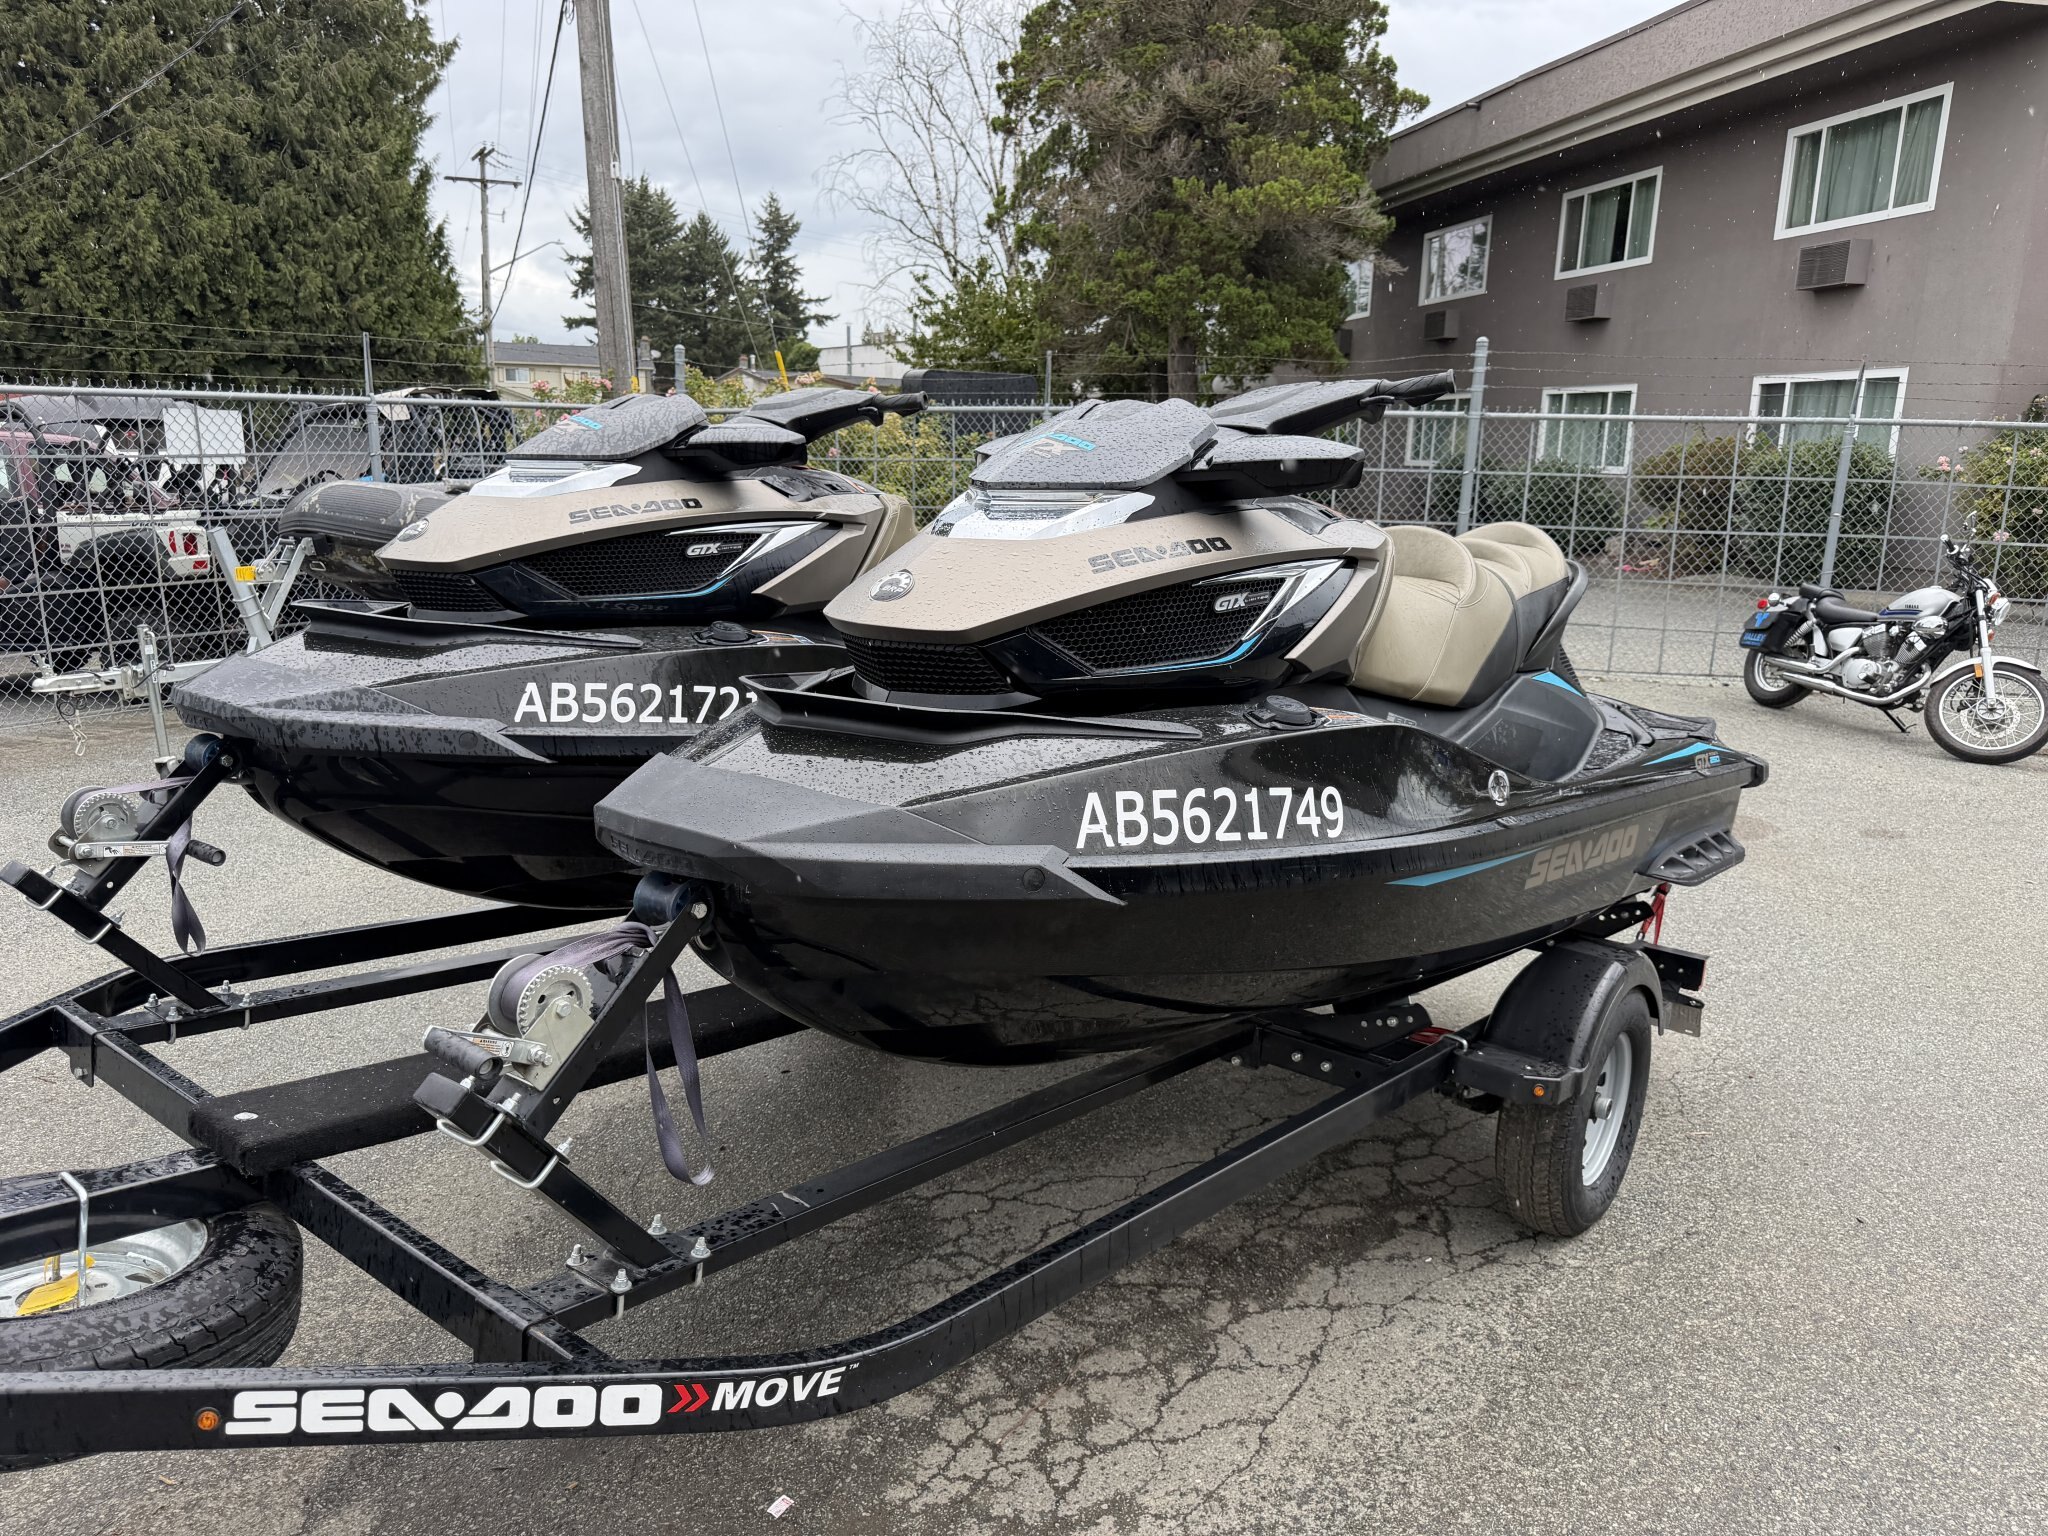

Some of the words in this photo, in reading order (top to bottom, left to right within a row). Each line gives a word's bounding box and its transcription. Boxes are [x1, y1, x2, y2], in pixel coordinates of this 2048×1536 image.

[687, 543, 721, 555] GTX
[1214, 592, 1249, 611] GTX
[1076, 786, 1344, 849] AB5621749
[711, 1366, 846, 1411] MOVE
